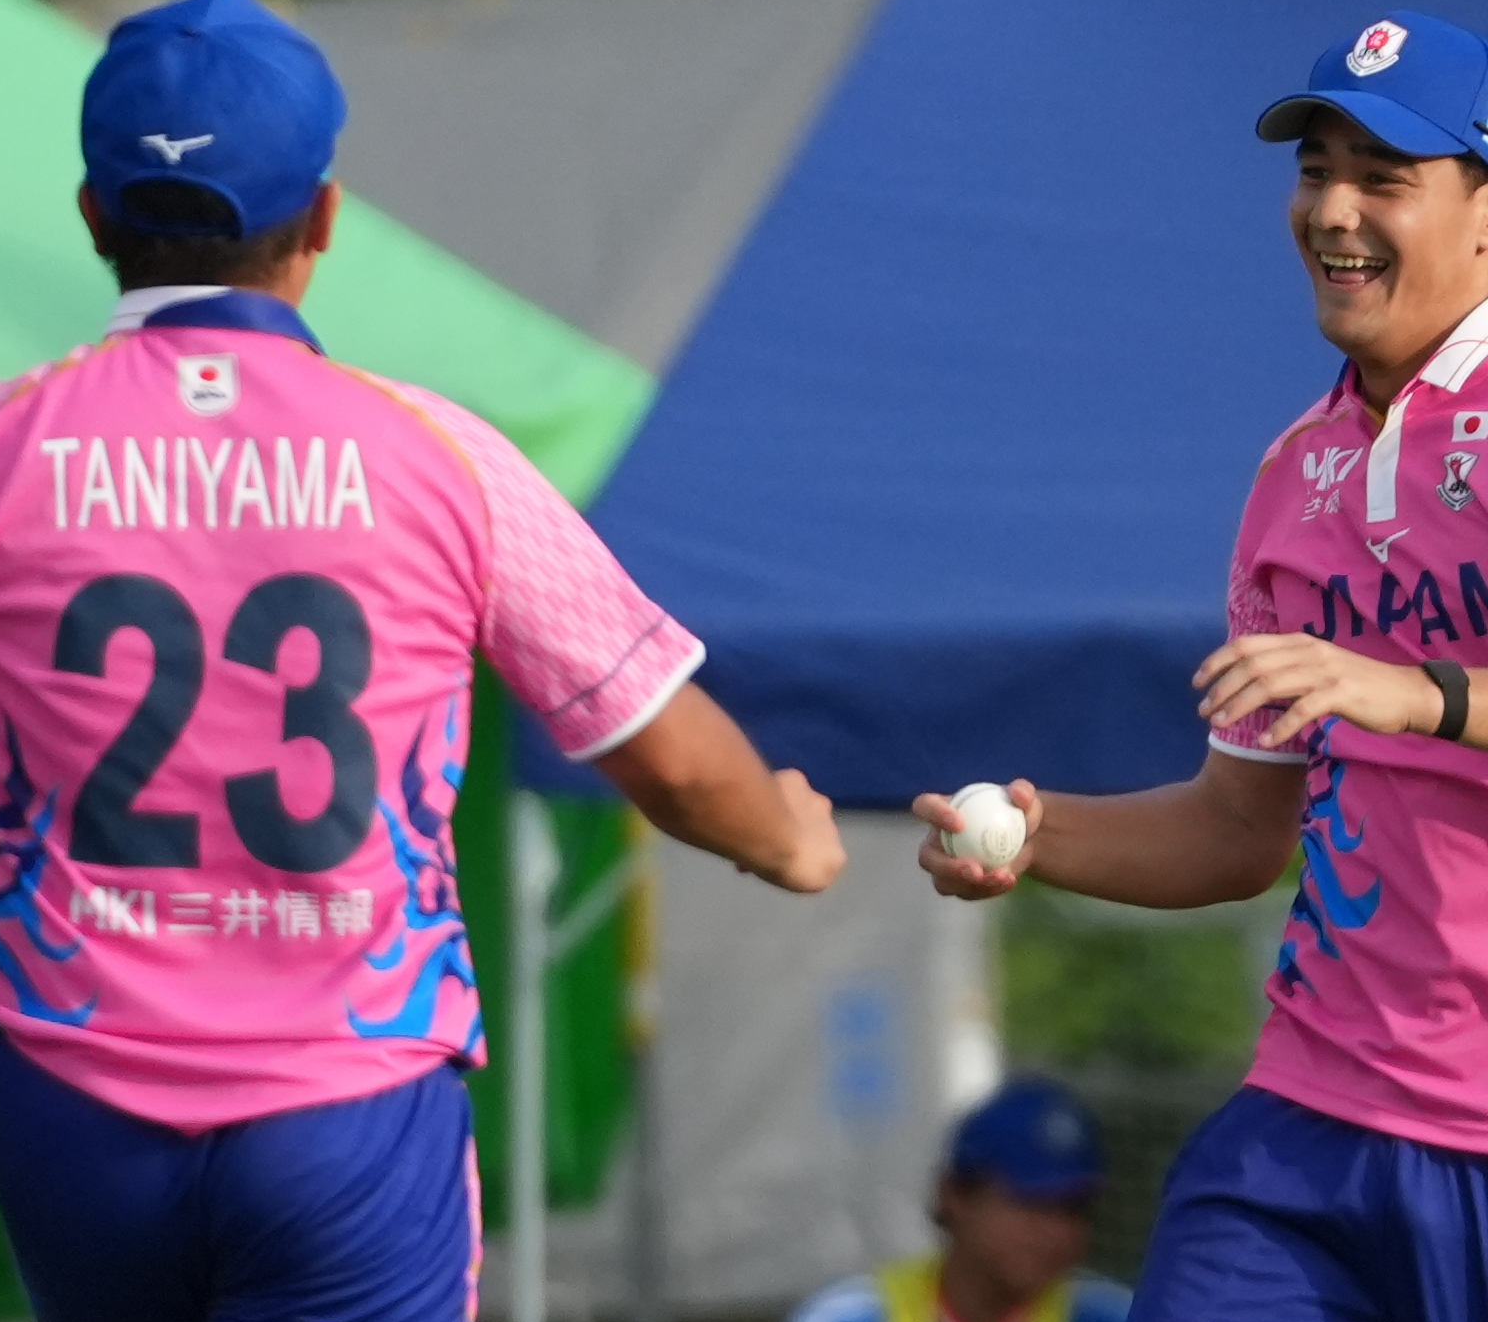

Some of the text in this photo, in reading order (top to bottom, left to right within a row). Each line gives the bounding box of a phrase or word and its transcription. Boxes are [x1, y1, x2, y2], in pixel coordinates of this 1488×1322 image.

[39, 436, 375, 530] TANIYAMA
[53, 571, 380, 874] 23
[69, 885, 375, 938] MKI 三井情報
